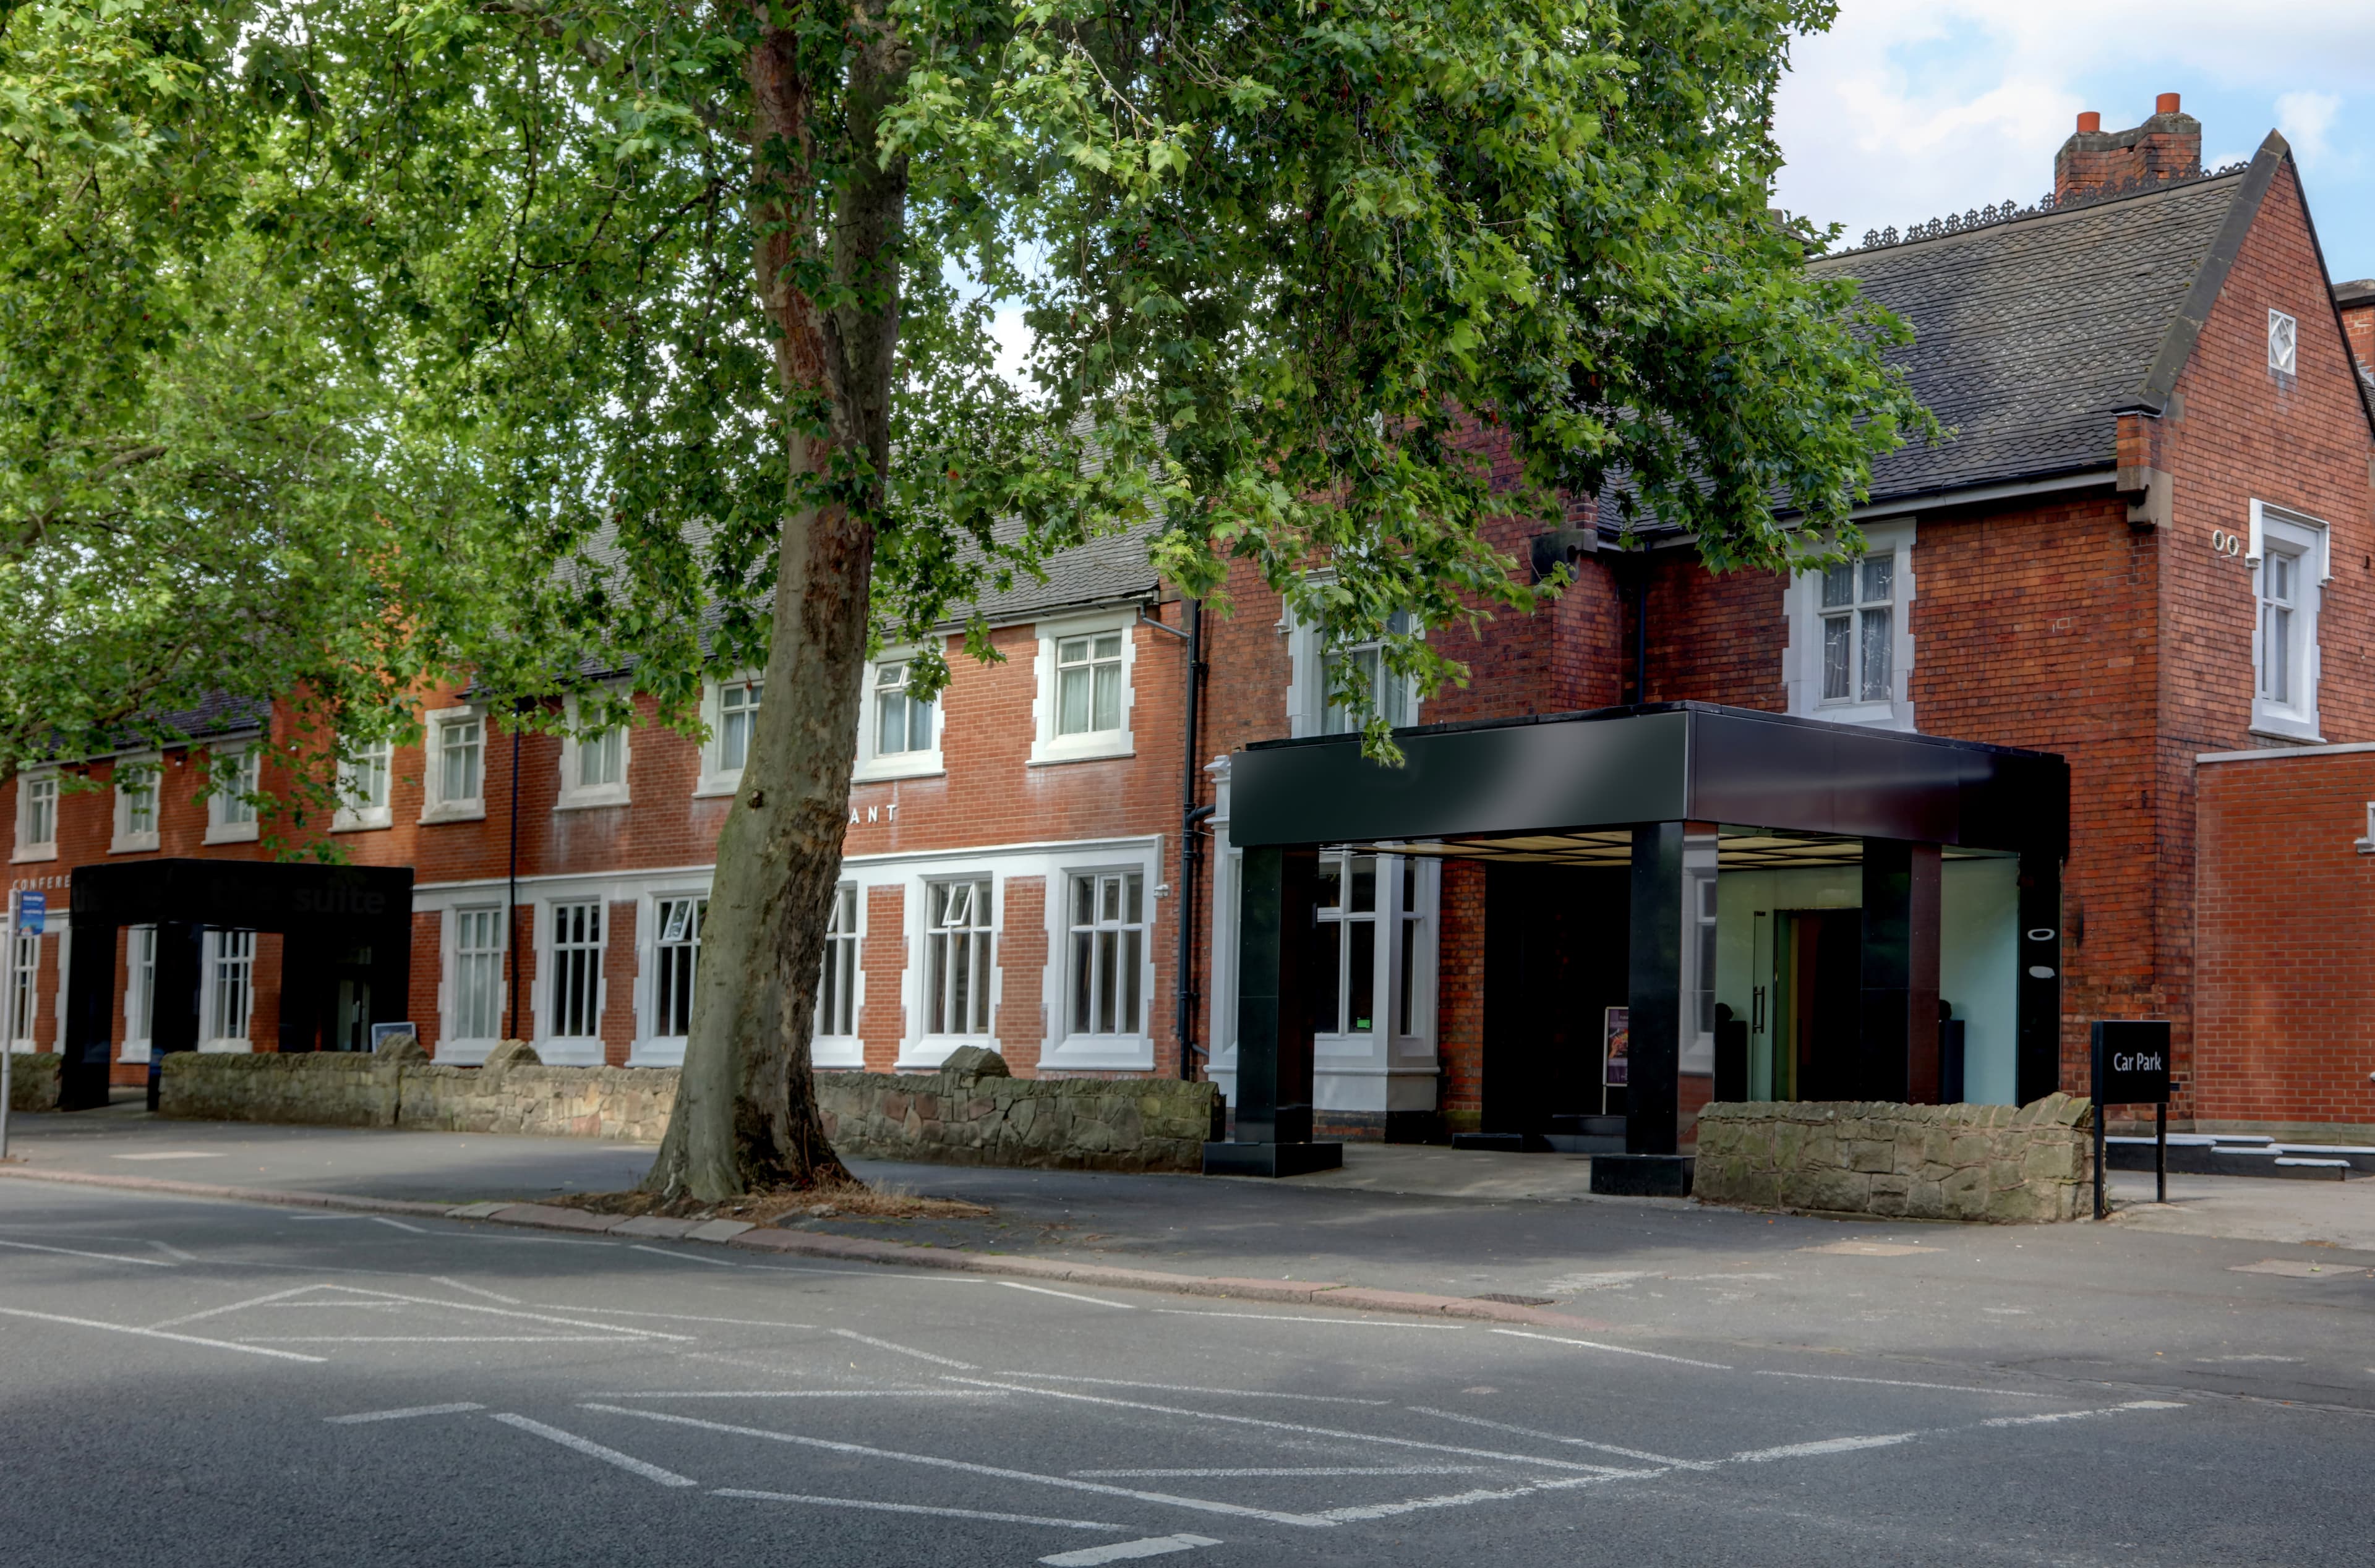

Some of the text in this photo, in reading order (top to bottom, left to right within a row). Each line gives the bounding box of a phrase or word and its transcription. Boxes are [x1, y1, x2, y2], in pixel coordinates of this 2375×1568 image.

[849, 804, 897, 825] ANT
[210, 877, 387, 914] the suite
[2113, 1050, 2162, 1072] Car Park
